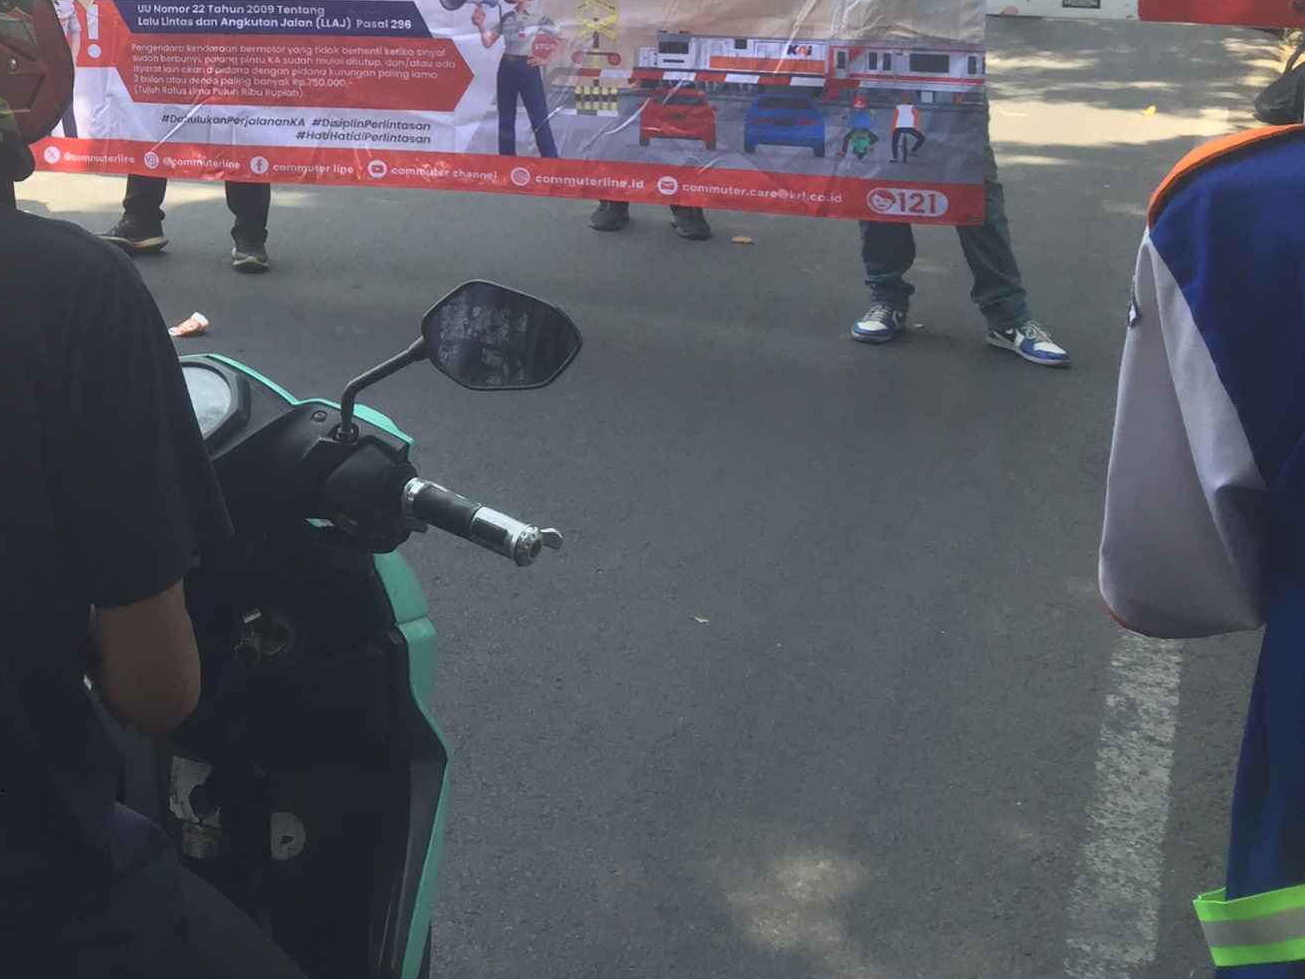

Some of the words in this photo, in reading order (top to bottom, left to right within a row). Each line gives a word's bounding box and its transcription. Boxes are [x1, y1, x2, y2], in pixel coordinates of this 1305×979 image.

[137, 4, 151, 14] UU
[153, 4, 191, 14] Nomor
[192, 4, 205, 14] 22
[208, 4, 245, 14] Tahun
[246, 5, 275, 14] 2009
[276, 5, 326, 17] Tentang
[137, 17, 160, 27] Lalu
[161, 17, 194, 27] Lintas
[195, 17, 218, 27] dan
[220, 17, 279, 29] Angkutan
[280, 18, 313, 27] Jalan
[315, 16, 352, 30] (LLAJ)
[355, 19, 389, 29] Pasal
[390, 19, 412, 29] 296
[287, 46, 312, 56] yang
[314, 46, 340, 55] tidak
[267, 56, 281, 64] KA
[283, 56, 313, 65] sudah
[251, 67, 291, 77] dengan
[378, 69, 410, 80] paling
[272, 164, 330, 175] commuter
[535, 174, 645, 190] commuterline.id
[898, 191, 936, 214] 121
